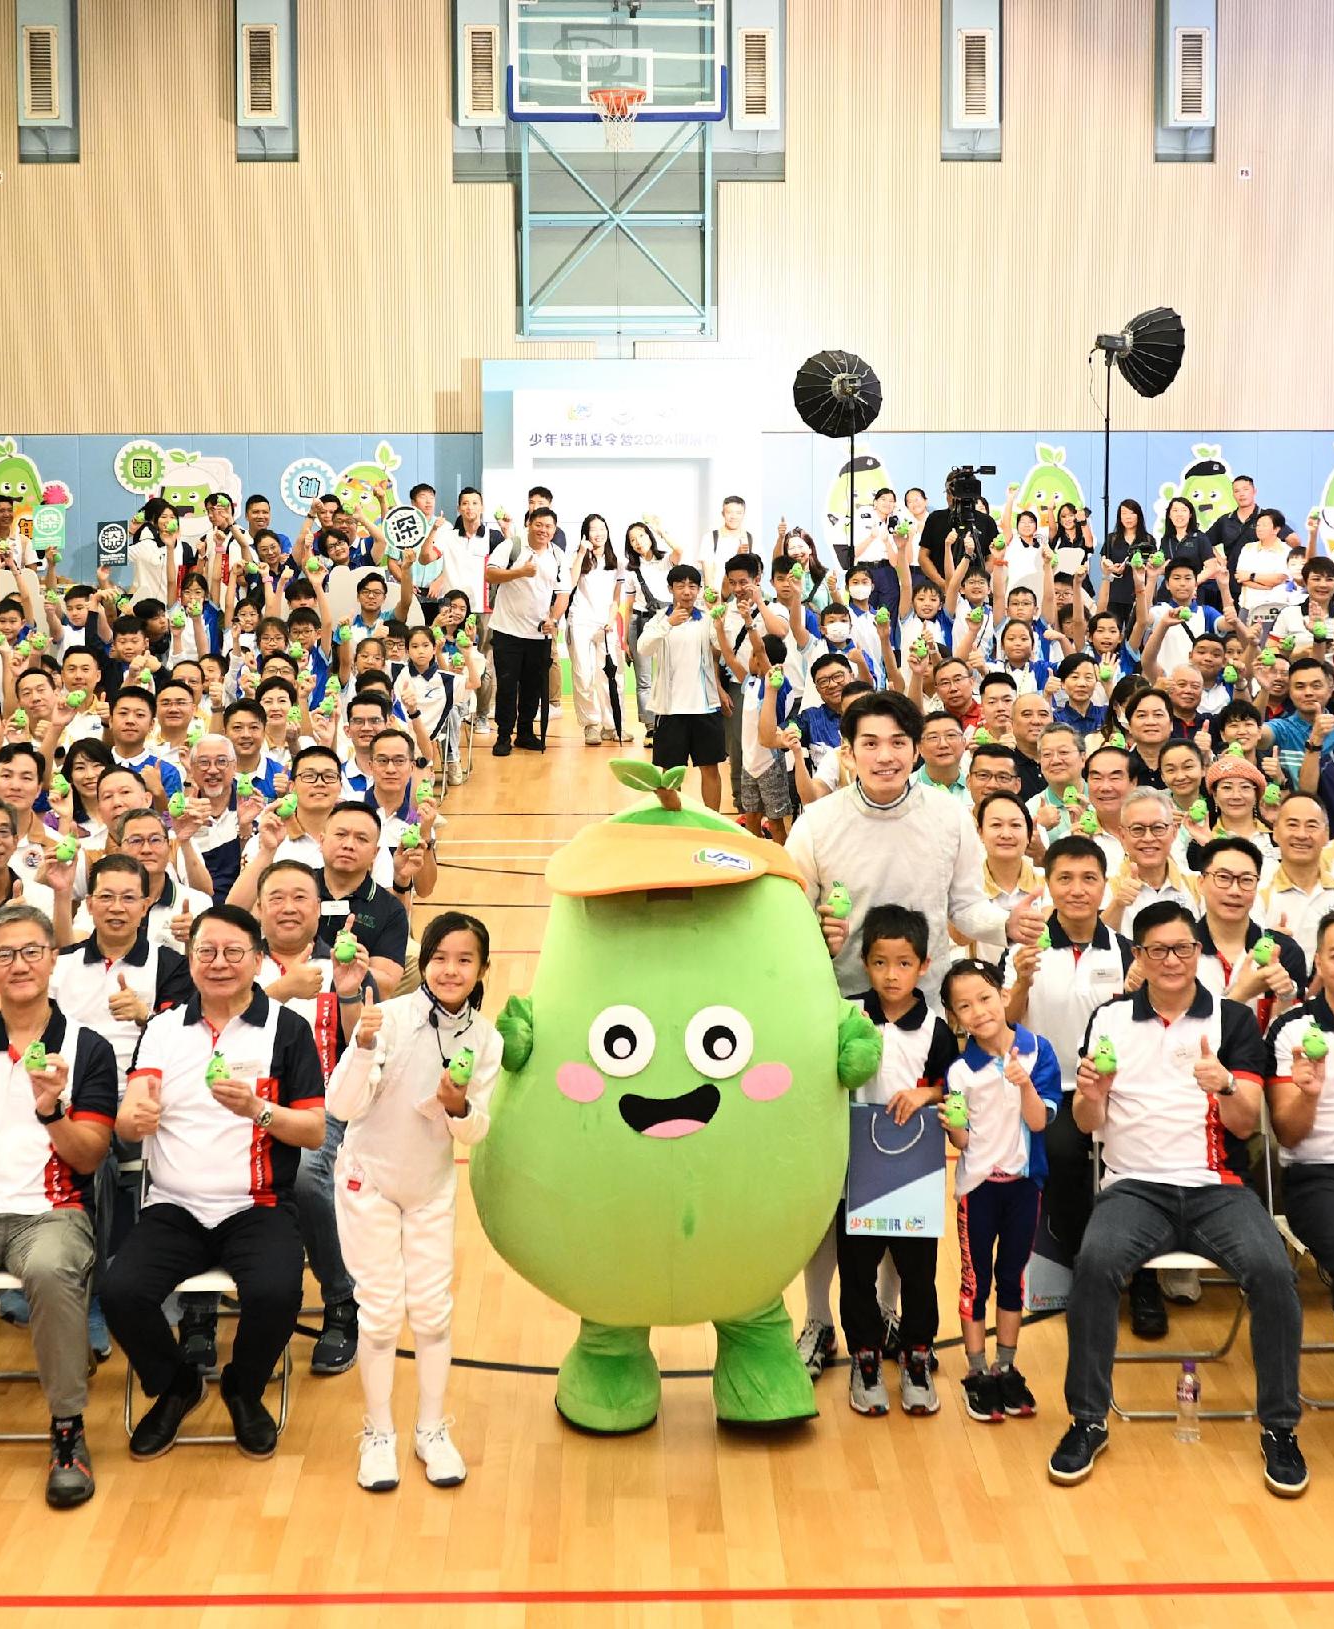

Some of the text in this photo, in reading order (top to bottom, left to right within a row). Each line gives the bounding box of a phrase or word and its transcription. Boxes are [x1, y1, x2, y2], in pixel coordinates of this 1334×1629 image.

[392, 514, 419, 543] 深
[850, 1216, 901, 1231] 少年警訊
